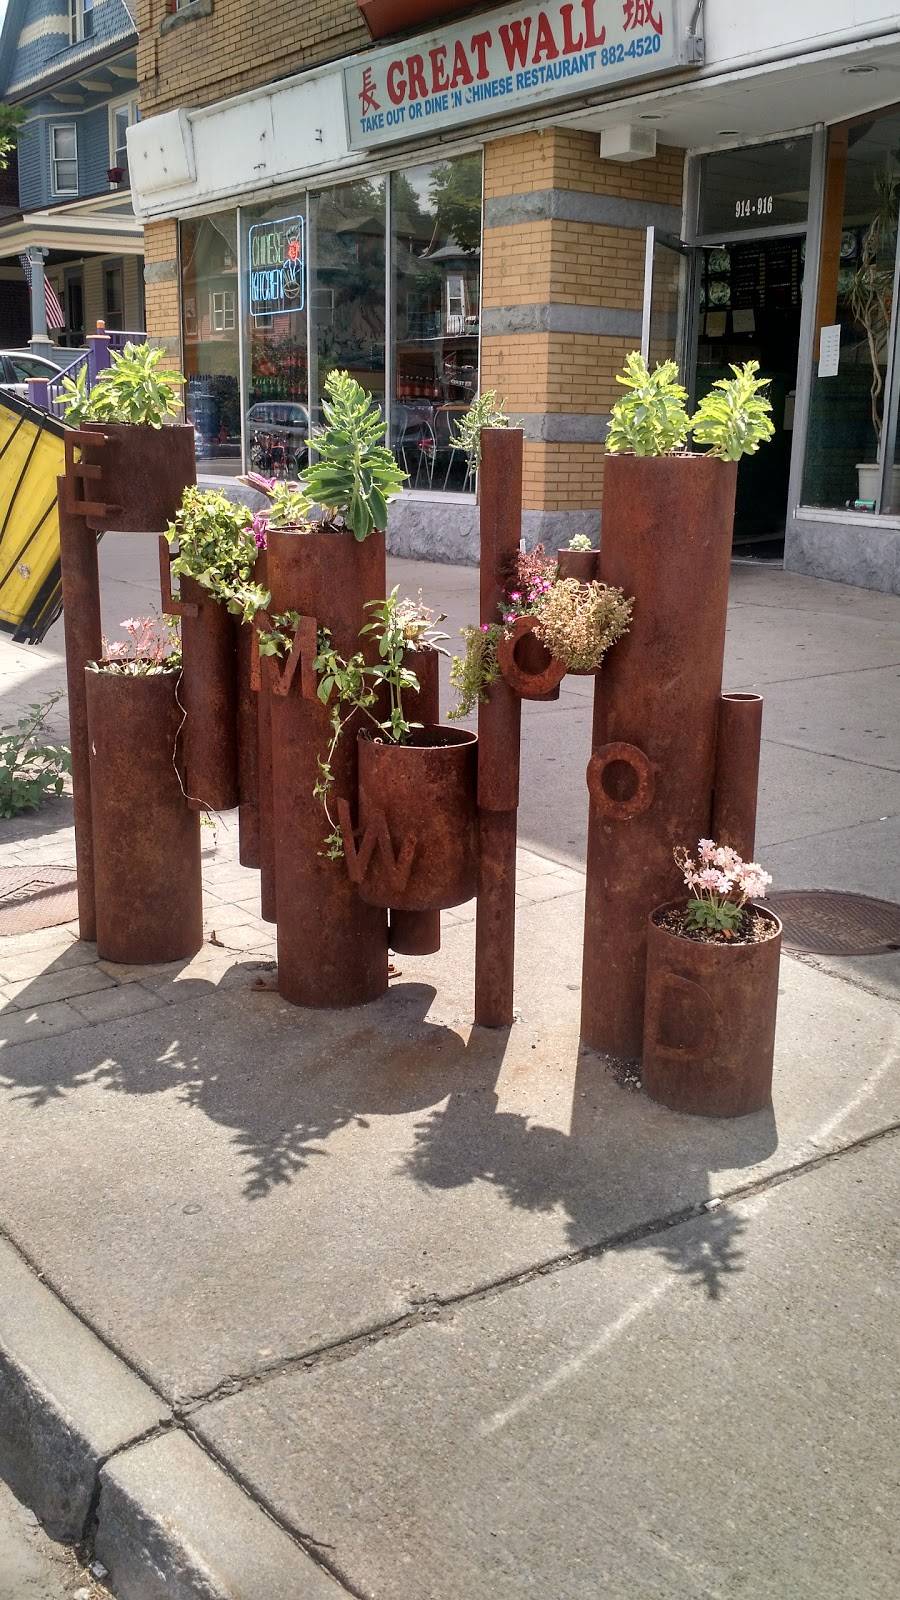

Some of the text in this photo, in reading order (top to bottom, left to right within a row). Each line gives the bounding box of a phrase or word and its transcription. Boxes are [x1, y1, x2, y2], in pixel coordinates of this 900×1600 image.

[360, 111, 385, 134] TAKE
[386, 106, 406, 126] OUT
[408, 101, 423, 120] OR
[424, 94, 449, 117] DINE
[516, 50, 597, 91] RESTAURANT
[601, 33, 661, 67] 882-4520
[386, 0, 606, 106] GREAT WALL
